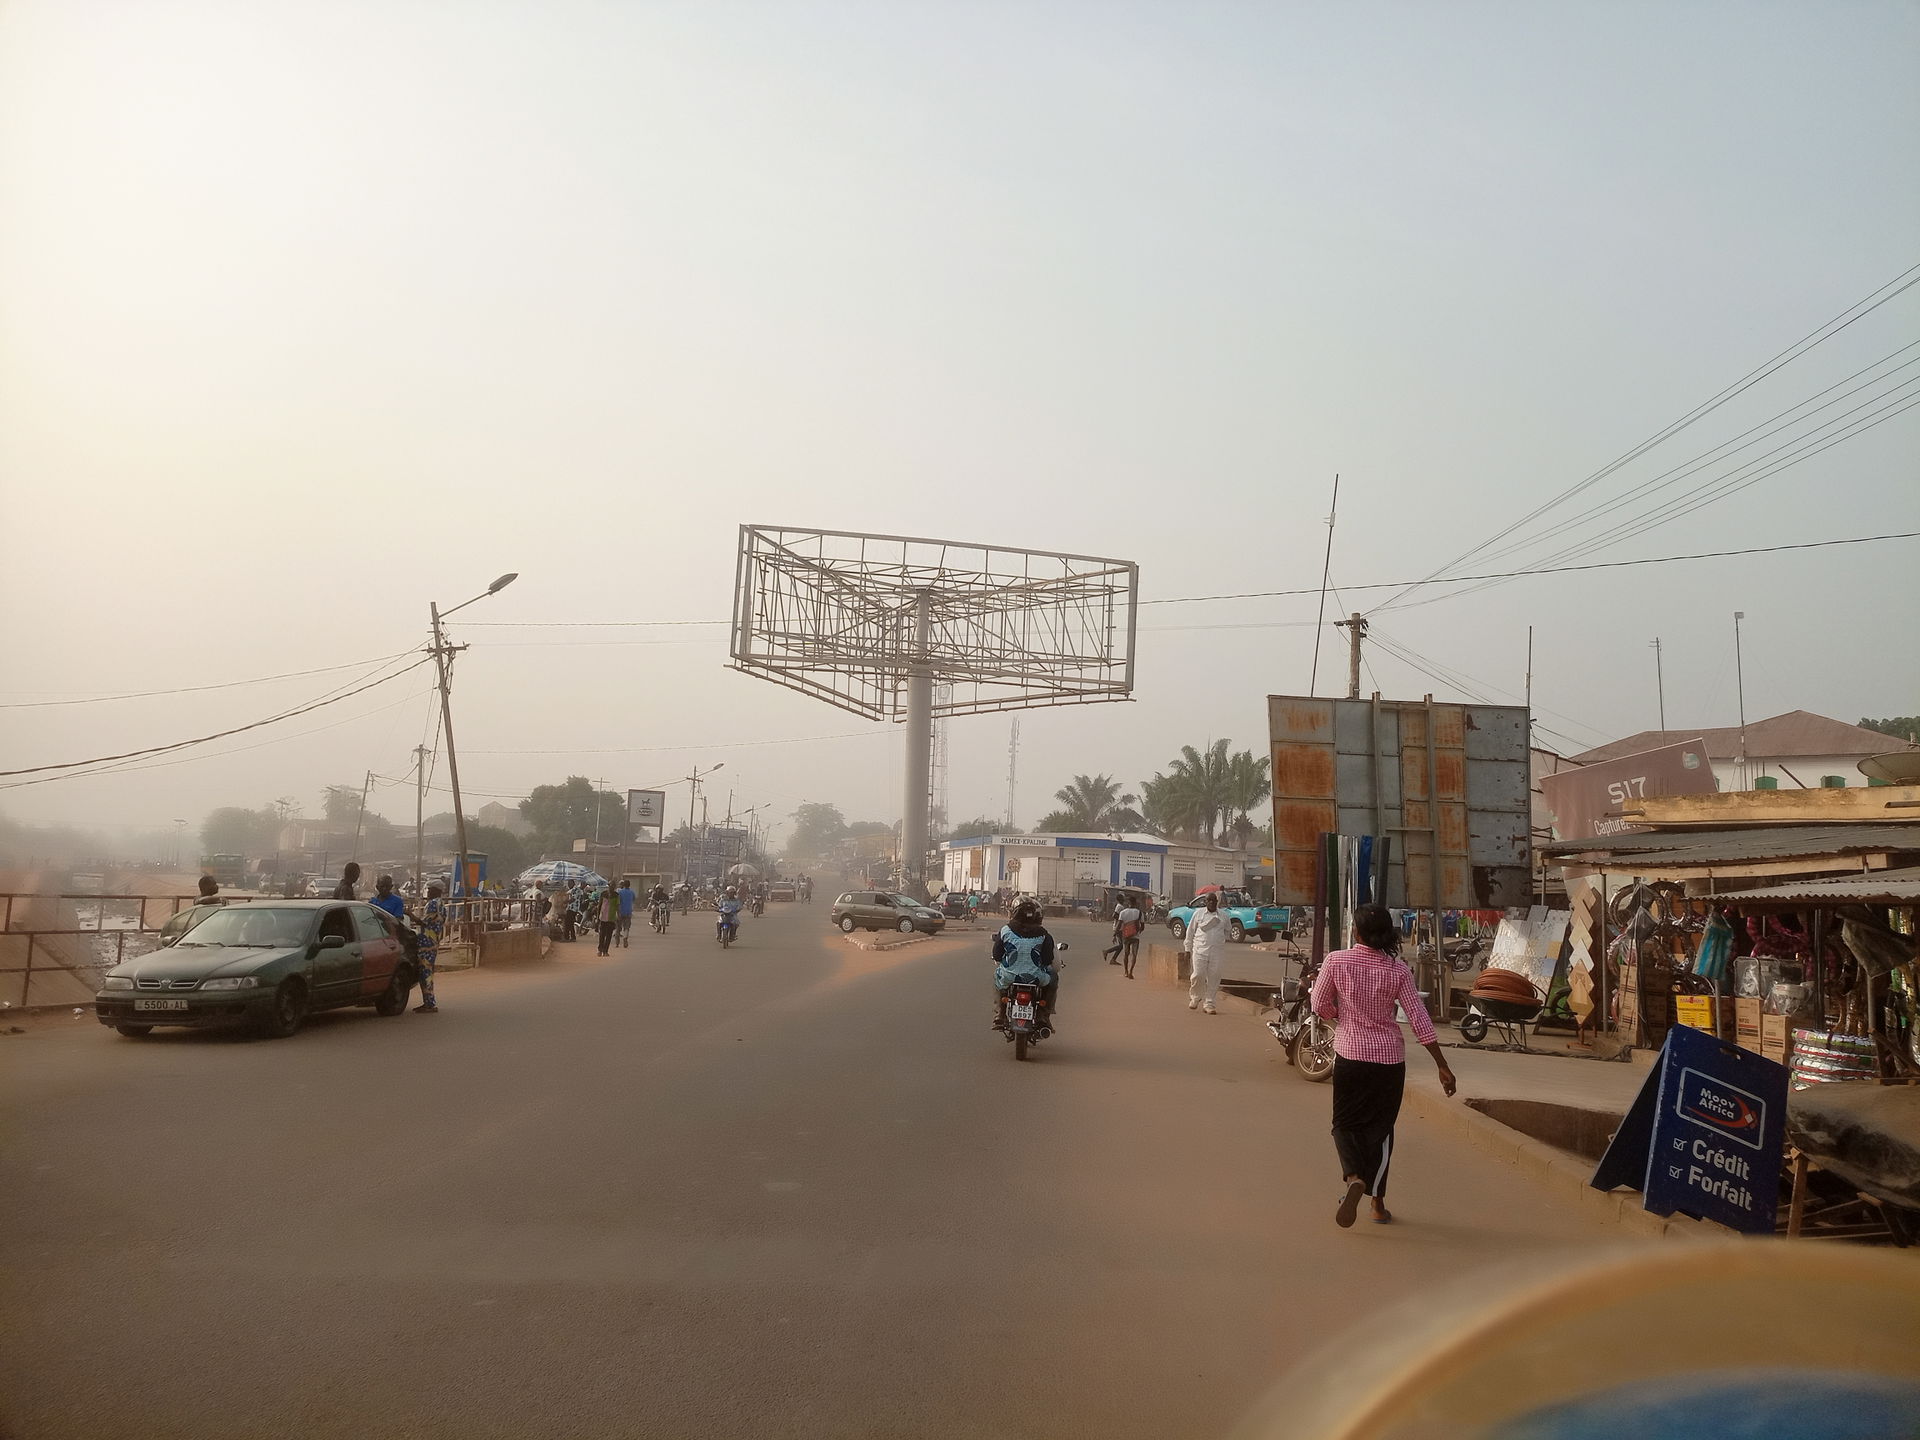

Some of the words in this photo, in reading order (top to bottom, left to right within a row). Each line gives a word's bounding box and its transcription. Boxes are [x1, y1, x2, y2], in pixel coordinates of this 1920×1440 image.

[1699, 1098, 1735, 1119] Africa
[1700, 1088, 1735, 1109] Moov
[1692, 1139, 1750, 1181] Crédit
[1688, 1165, 1753, 1211] Forfait
